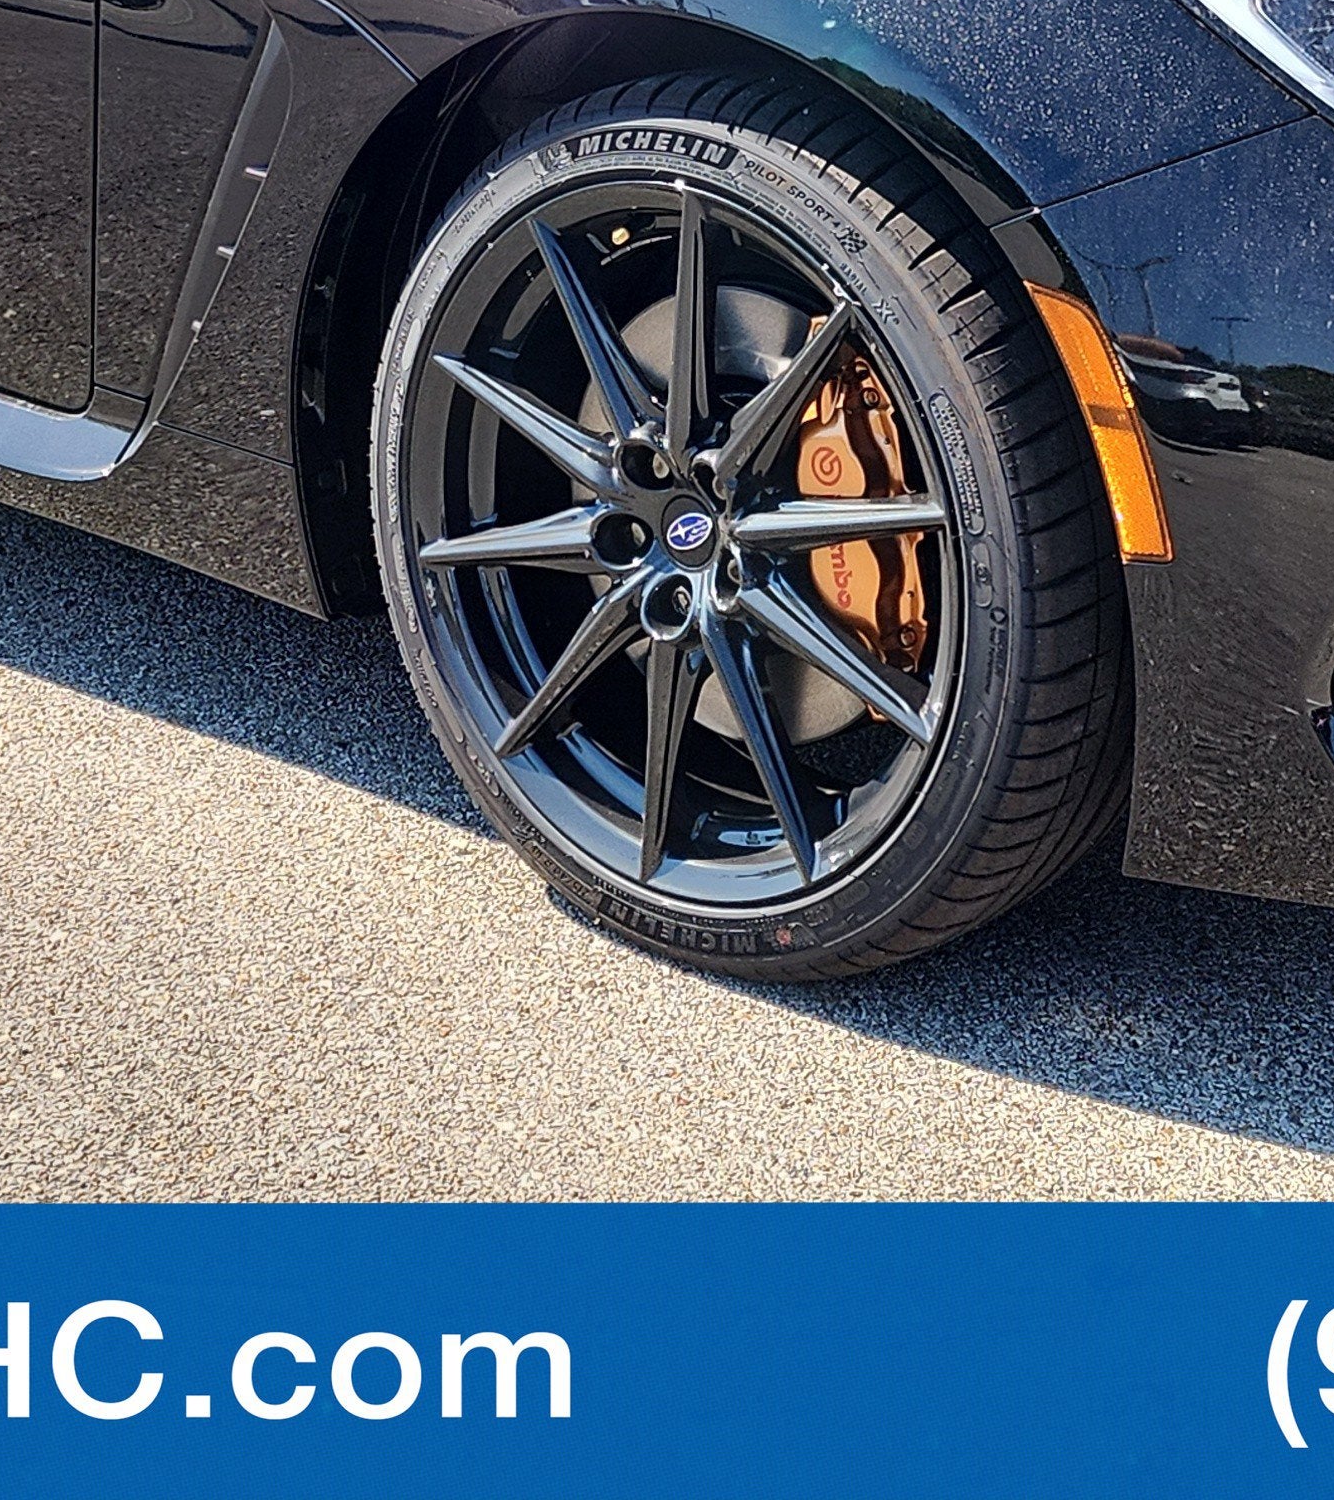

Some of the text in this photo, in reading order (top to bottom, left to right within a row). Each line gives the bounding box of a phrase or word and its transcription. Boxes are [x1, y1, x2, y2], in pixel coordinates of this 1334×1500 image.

[578, 129, 727, 164] MICHELIN
[745, 160, 787, 186] PILOT
[787, 185, 834, 221] SPORT
[829, 544, 853, 610] mbo
[607, 902, 758, 953] MICHELIN
